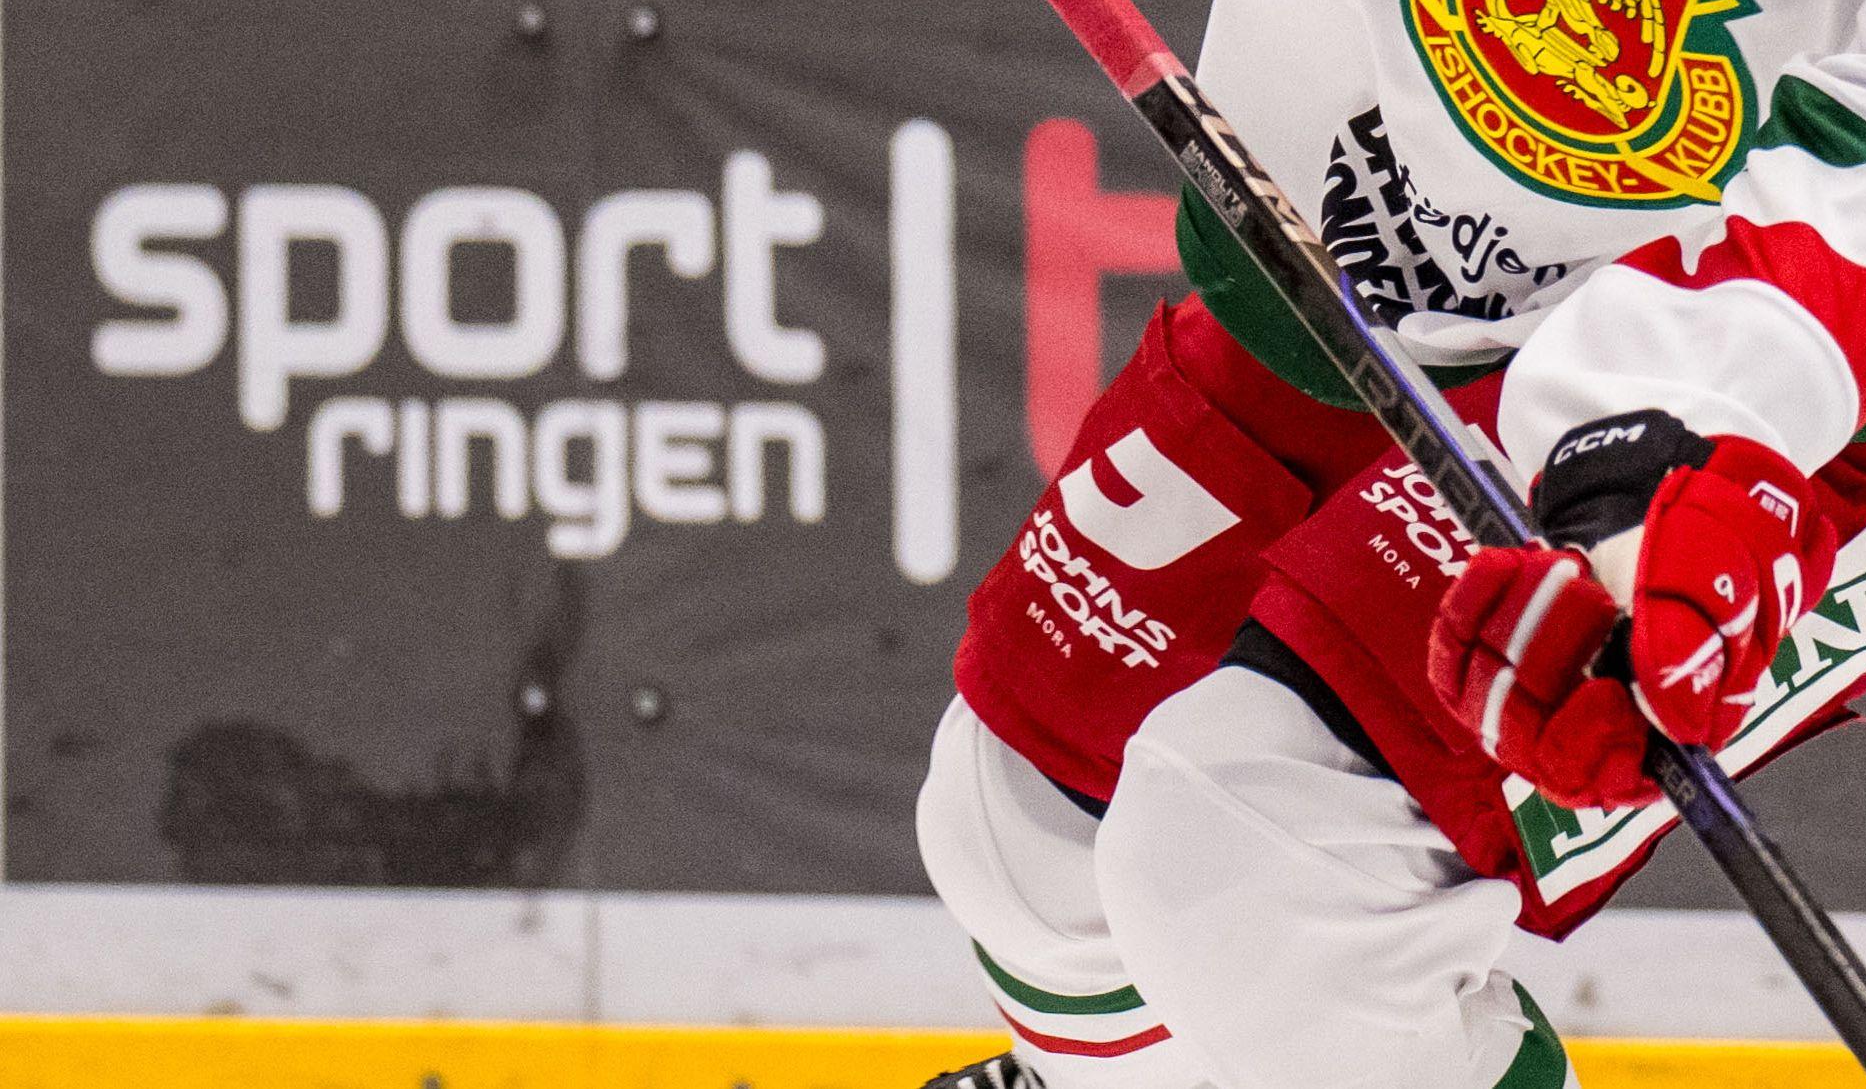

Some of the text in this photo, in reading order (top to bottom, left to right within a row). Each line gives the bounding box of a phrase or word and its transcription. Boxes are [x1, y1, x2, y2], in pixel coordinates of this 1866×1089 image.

[1665, 67, 1730, 182] KLUBB
[89, 182, 828, 432] sport
[308, 396, 828, 560] ringen
[1554, 423, 1647, 466] CCM
[1019, 530, 1160, 669] SPORT
[1033, 510, 1177, 652] JOHNS
[1368, 533, 1421, 590] MORA
[1025, 601, 1072, 659] MORA
